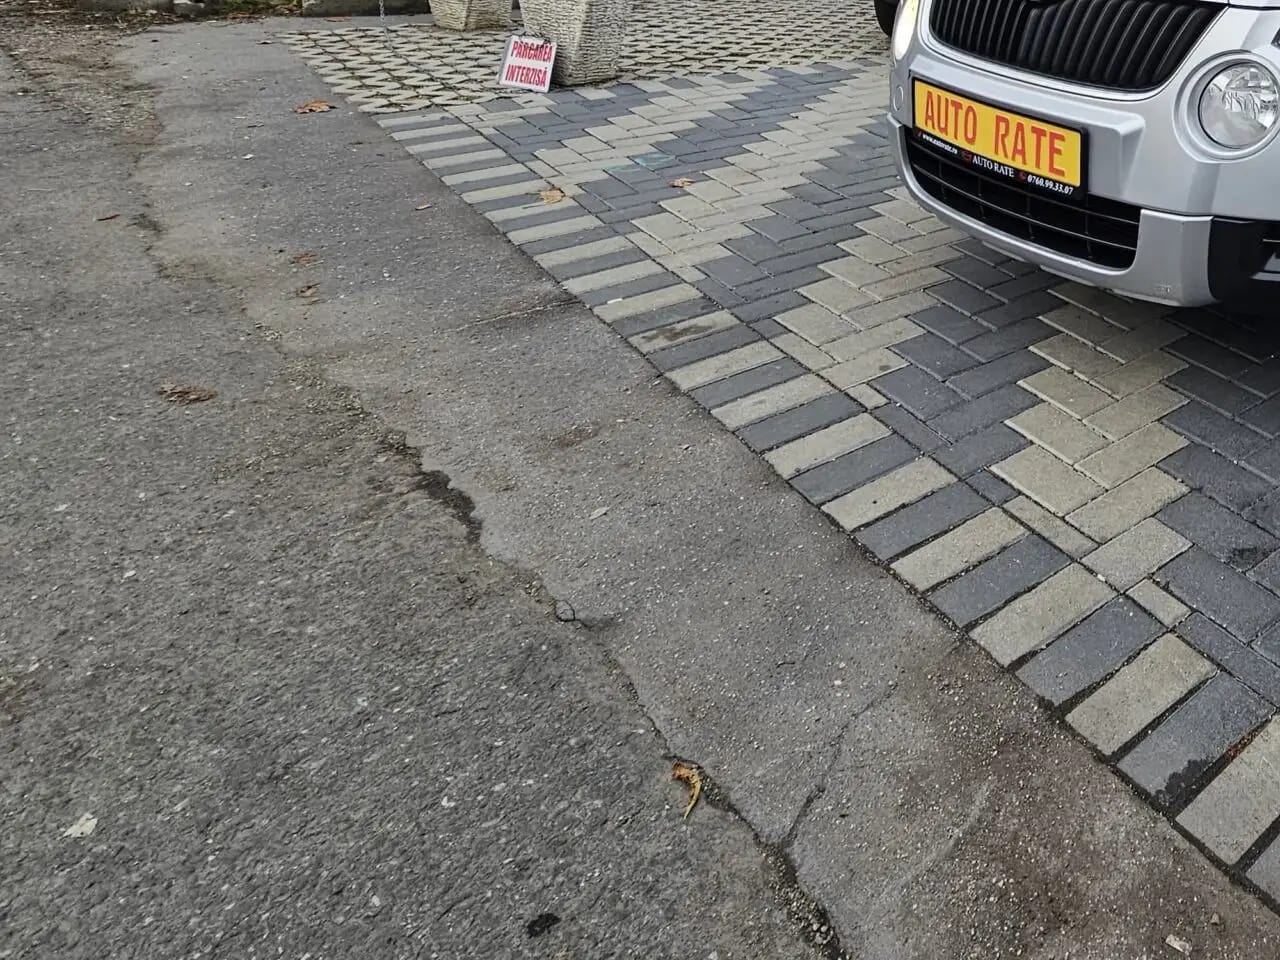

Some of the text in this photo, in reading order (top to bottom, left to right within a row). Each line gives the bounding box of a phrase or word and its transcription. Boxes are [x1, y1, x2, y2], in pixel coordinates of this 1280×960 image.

[511, 40, 553, 63] PARCAREA
[925, 90, 1066, 177] AUTO RATE
[972, 156, 993, 171] AUTO
[994, 162, 1015, 179] RATE
[1027, 174, 1074, 196] 0760.99.33.07
